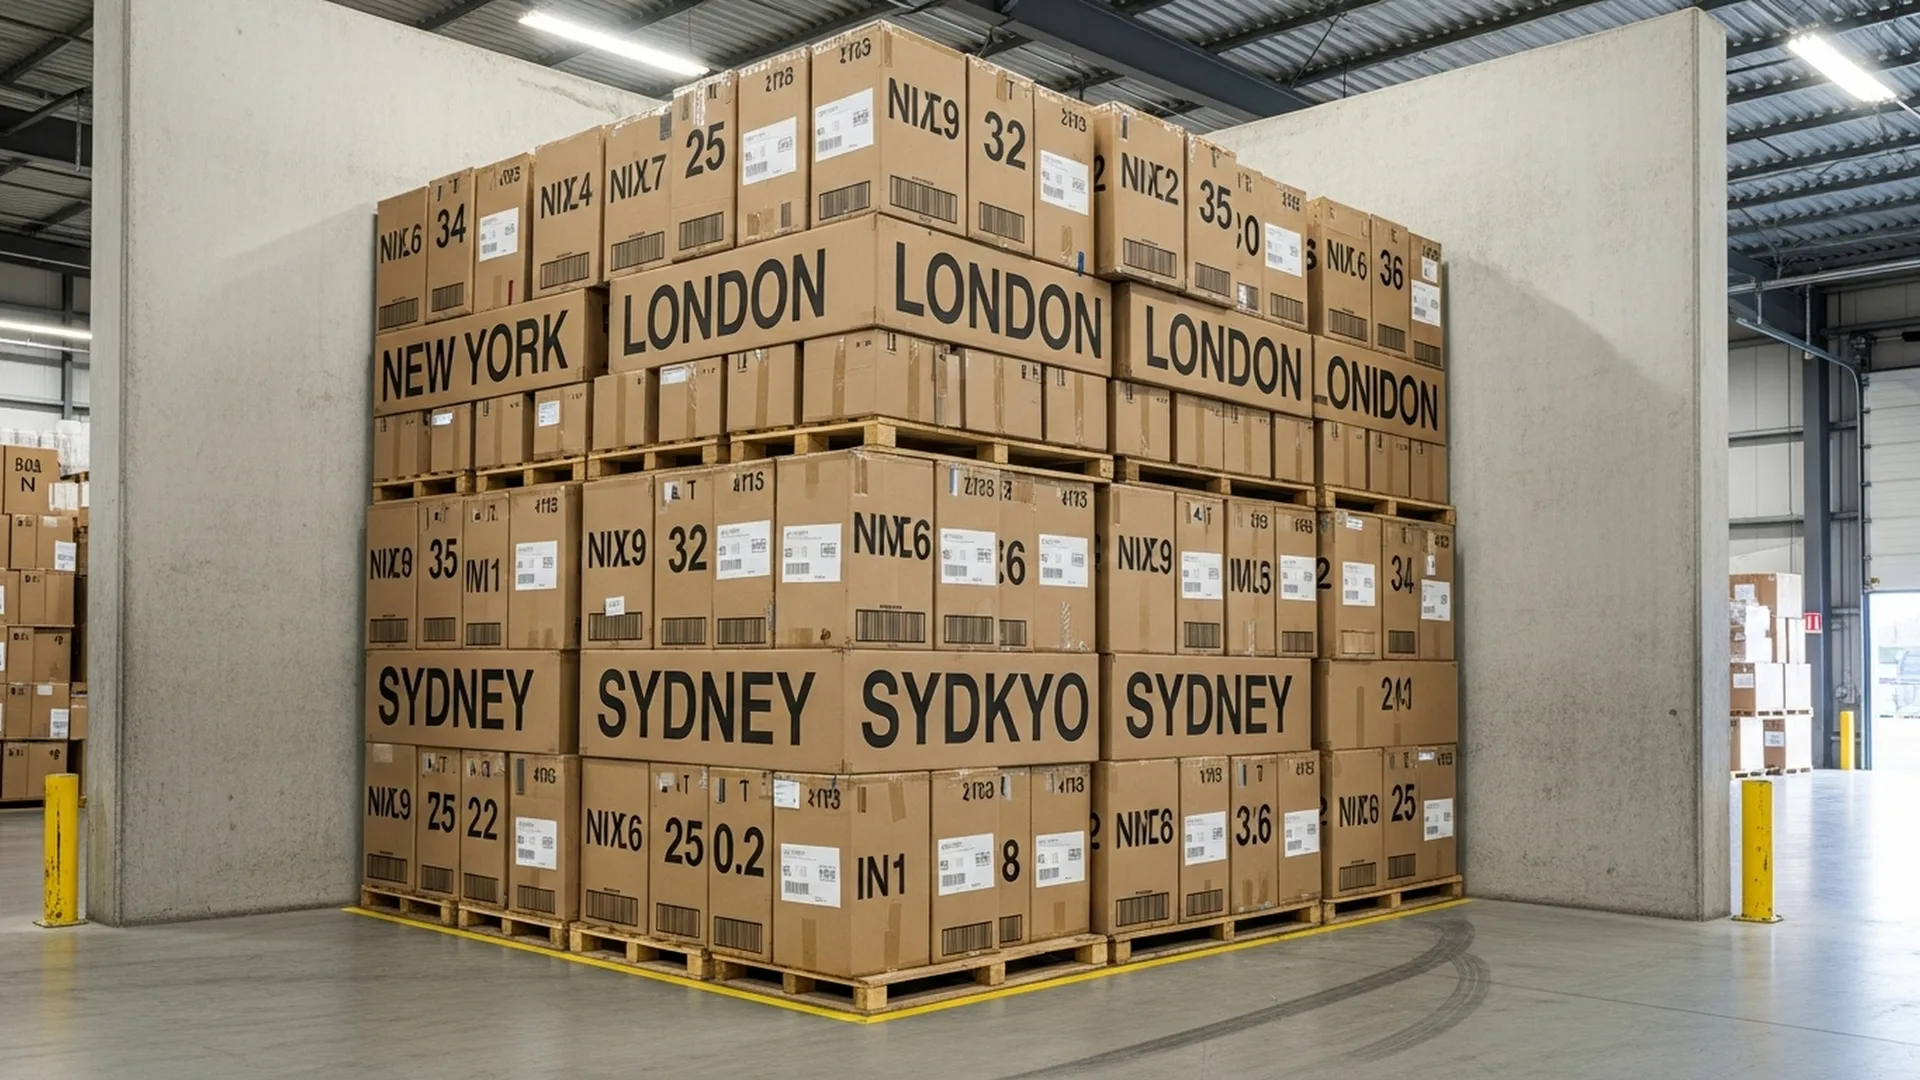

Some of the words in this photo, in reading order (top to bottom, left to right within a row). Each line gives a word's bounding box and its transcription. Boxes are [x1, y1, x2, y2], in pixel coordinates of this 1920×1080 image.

[686, 122, 724, 178] 25
[984, 111, 1025, 170] 32
[437, 204, 466, 248] 34
[1200, 180, 1232, 229] 35
[1380, 250, 1403, 290] 36
[624, 248, 826, 357] LONDON
[896, 242, 1102, 359] LONDON
[383, 337, 456, 403] NEW
[465, 309, 570, 387] YORK
[1145, 305, 1302, 401] LONDON
[22, 477, 35, 492] N
[429, 539, 457, 579] 35
[669, 525, 707, 573] 32
[1392, 555, 1414, 593] 34
[379, 666, 534, 730] SYDNEY
[598, 669, 815, 745] SYDNEY
[862, 670, 1088, 748] SYDKYO
[1126, 672, 1292, 738] SYDNEY
[428, 792, 455, 832] 25
[468, 797, 497, 840] 22
[1392, 784, 1416, 821] 25
[665, 818, 703, 866] 25
[714, 824, 764, 877] 0.2
[1002, 840, 1020, 882] 8
